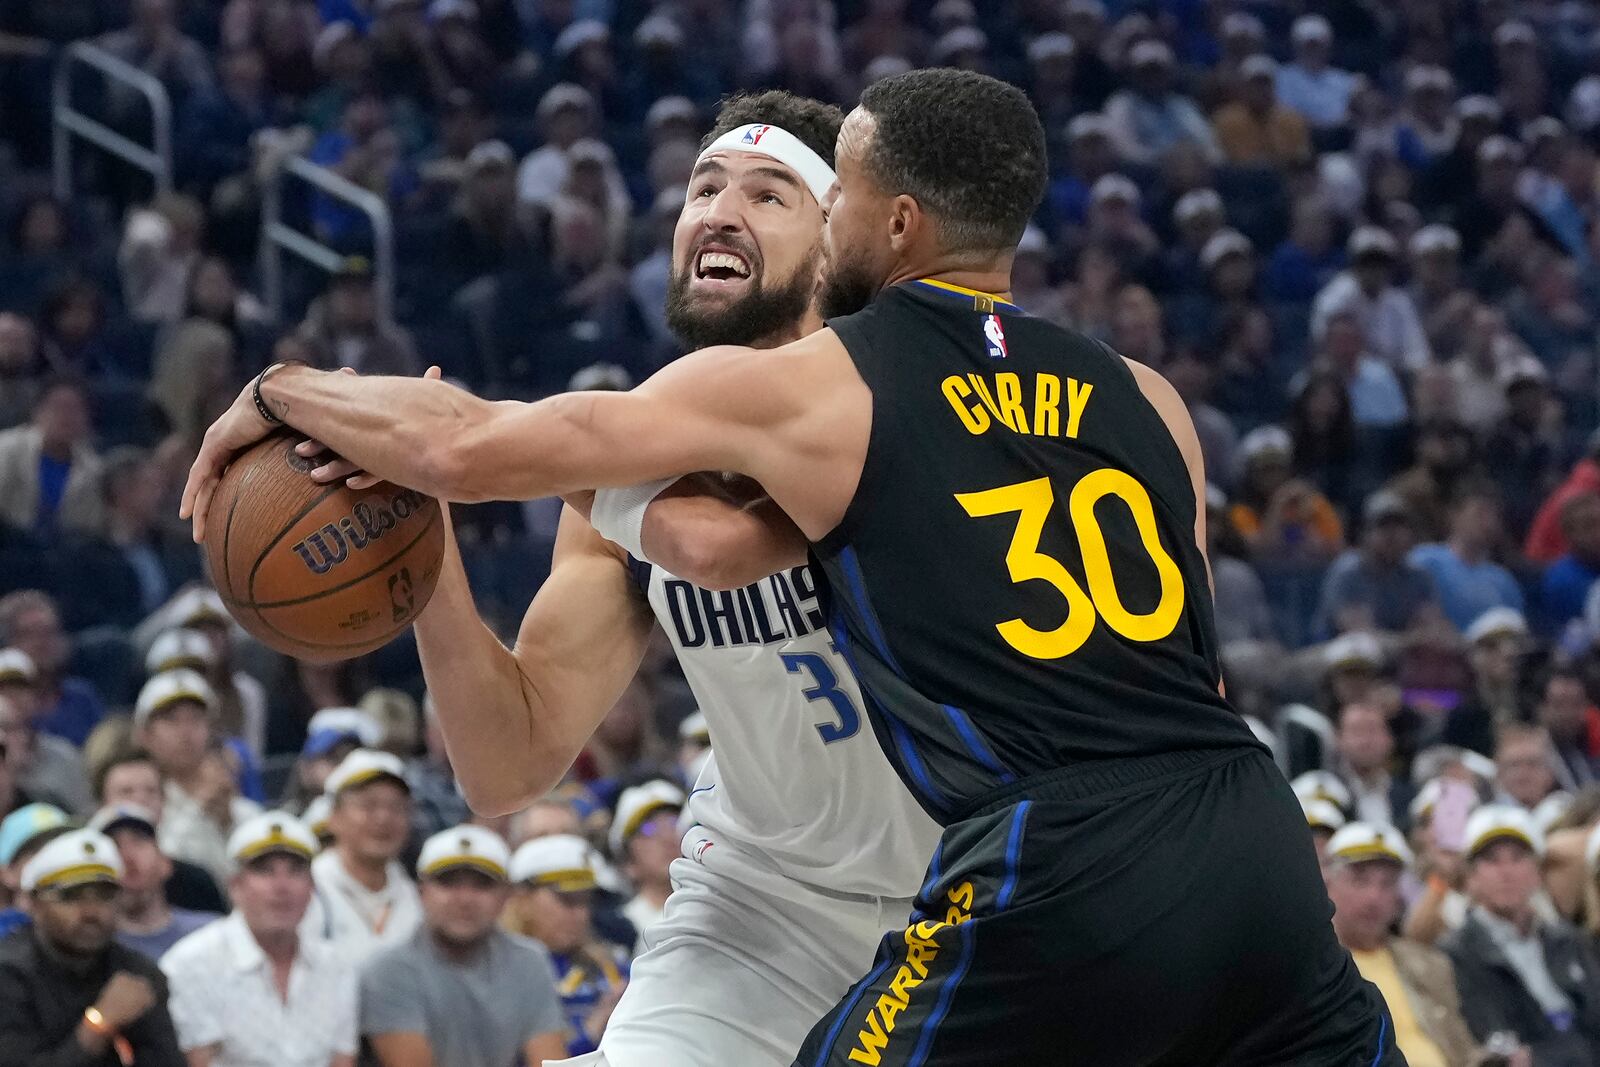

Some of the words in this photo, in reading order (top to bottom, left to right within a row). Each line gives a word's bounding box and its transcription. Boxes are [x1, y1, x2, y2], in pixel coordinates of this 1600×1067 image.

[941, 372, 1094, 439] CURRY
[953, 468, 1185, 660] 30
[777, 641, 862, 746] 3
